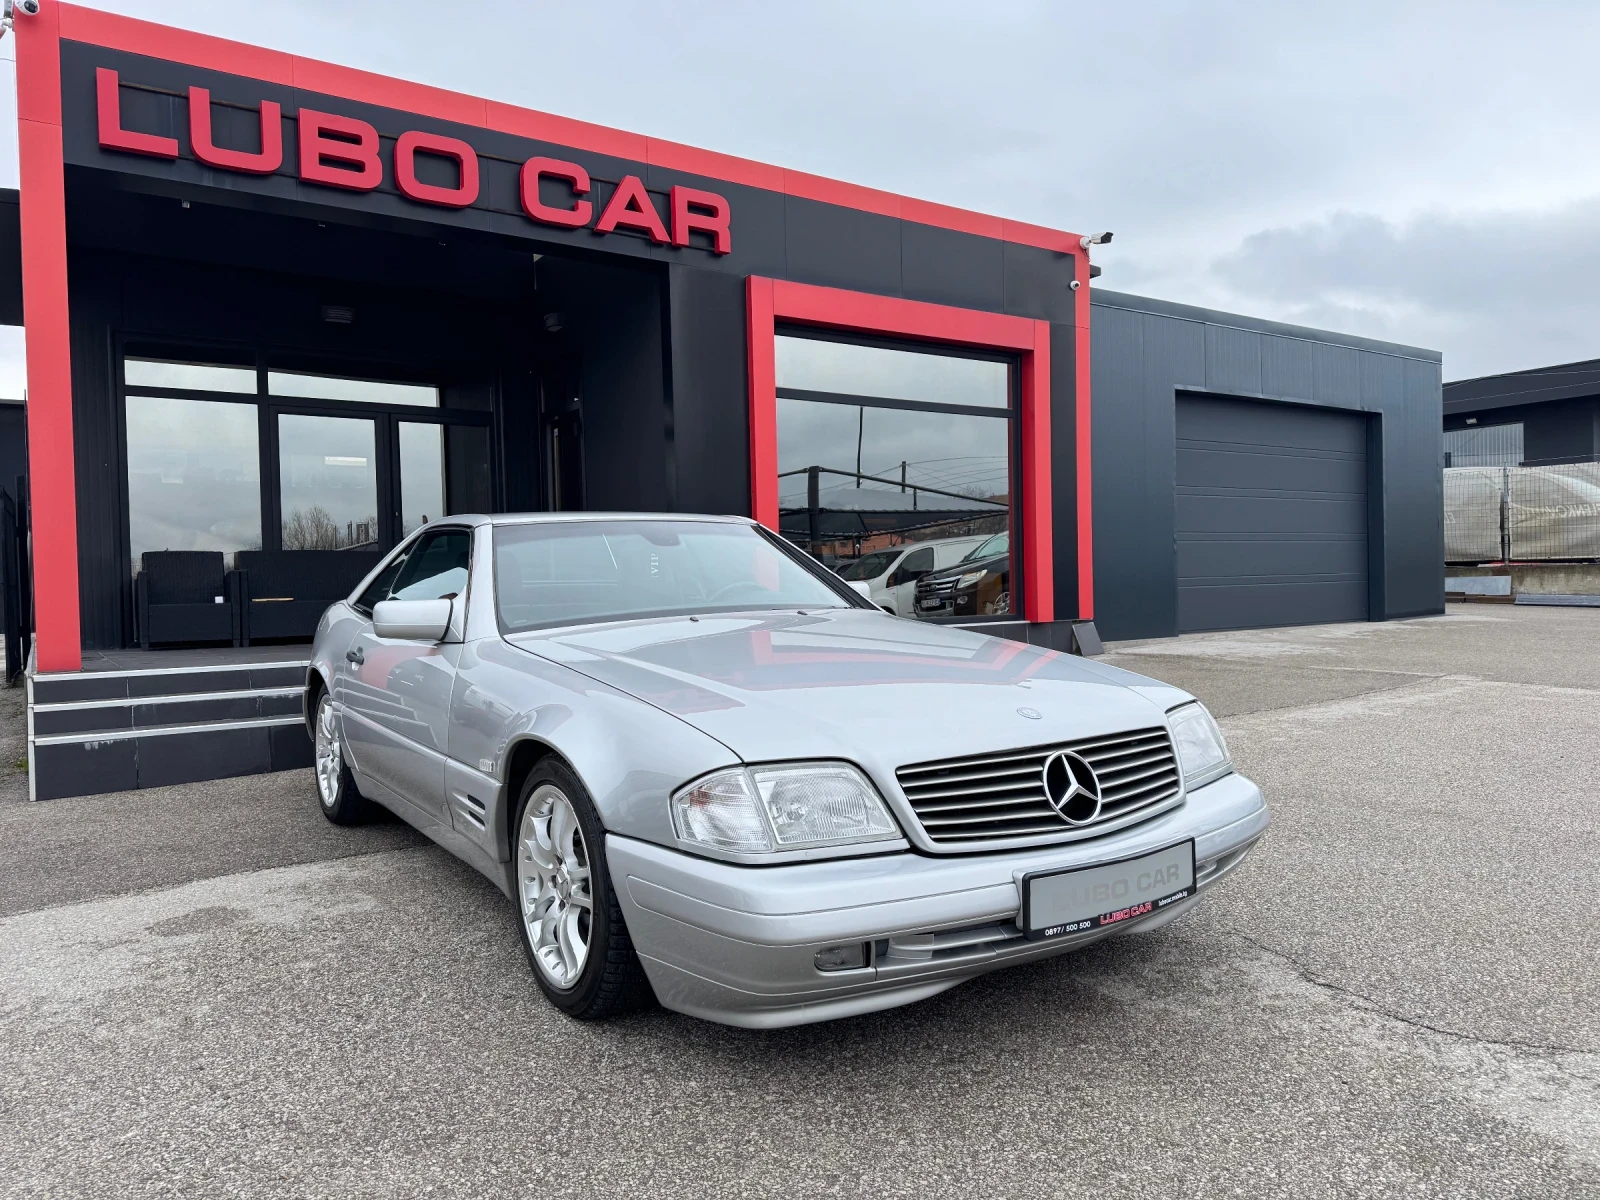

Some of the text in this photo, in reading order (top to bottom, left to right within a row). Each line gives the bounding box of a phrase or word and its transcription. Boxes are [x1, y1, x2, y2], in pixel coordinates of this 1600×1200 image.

[96, 67, 732, 255] LUBO CAR
[1053, 863, 1180, 912] LUBO CAR
[1044, 926, 1064, 936] 0897/
[1066, 923, 1078, 932] 500
[1079, 920, 1091, 930] 500
[1099, 908, 1130, 925] LUBO
[1130, 901, 1153, 917] CAR
